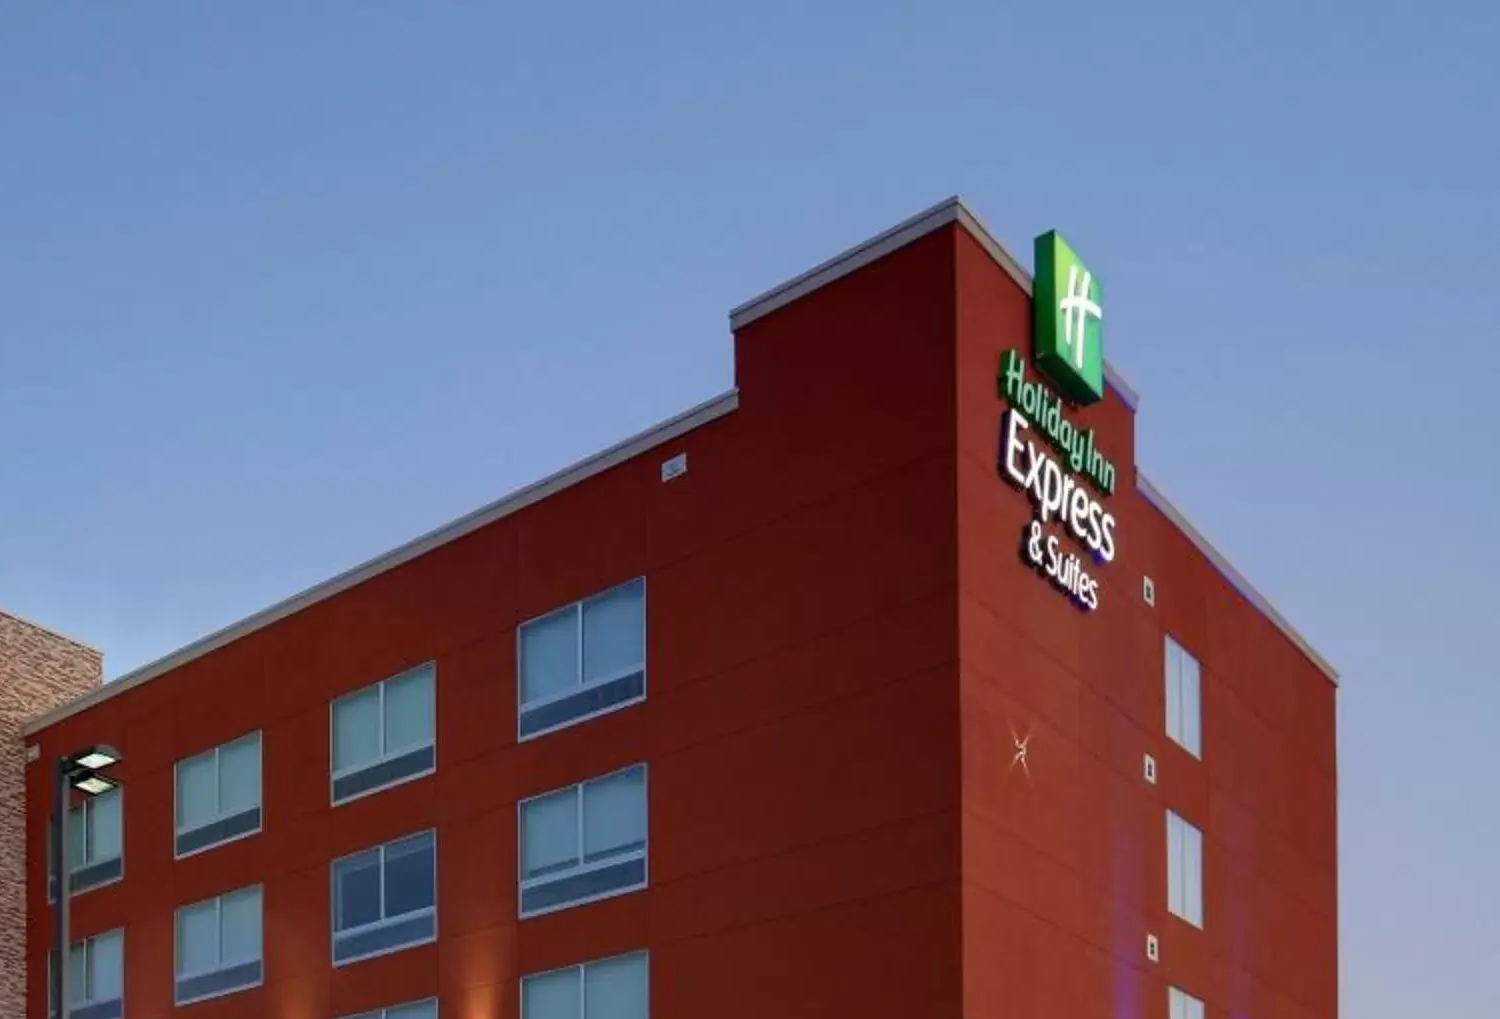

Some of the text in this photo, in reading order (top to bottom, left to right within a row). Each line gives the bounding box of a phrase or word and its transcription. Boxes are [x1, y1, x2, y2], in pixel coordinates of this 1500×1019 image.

[1005, 348, 1115, 493] Holiday Inn
[1006, 408, 1115, 562] Express
[1028, 520, 1098, 610] & Suites
